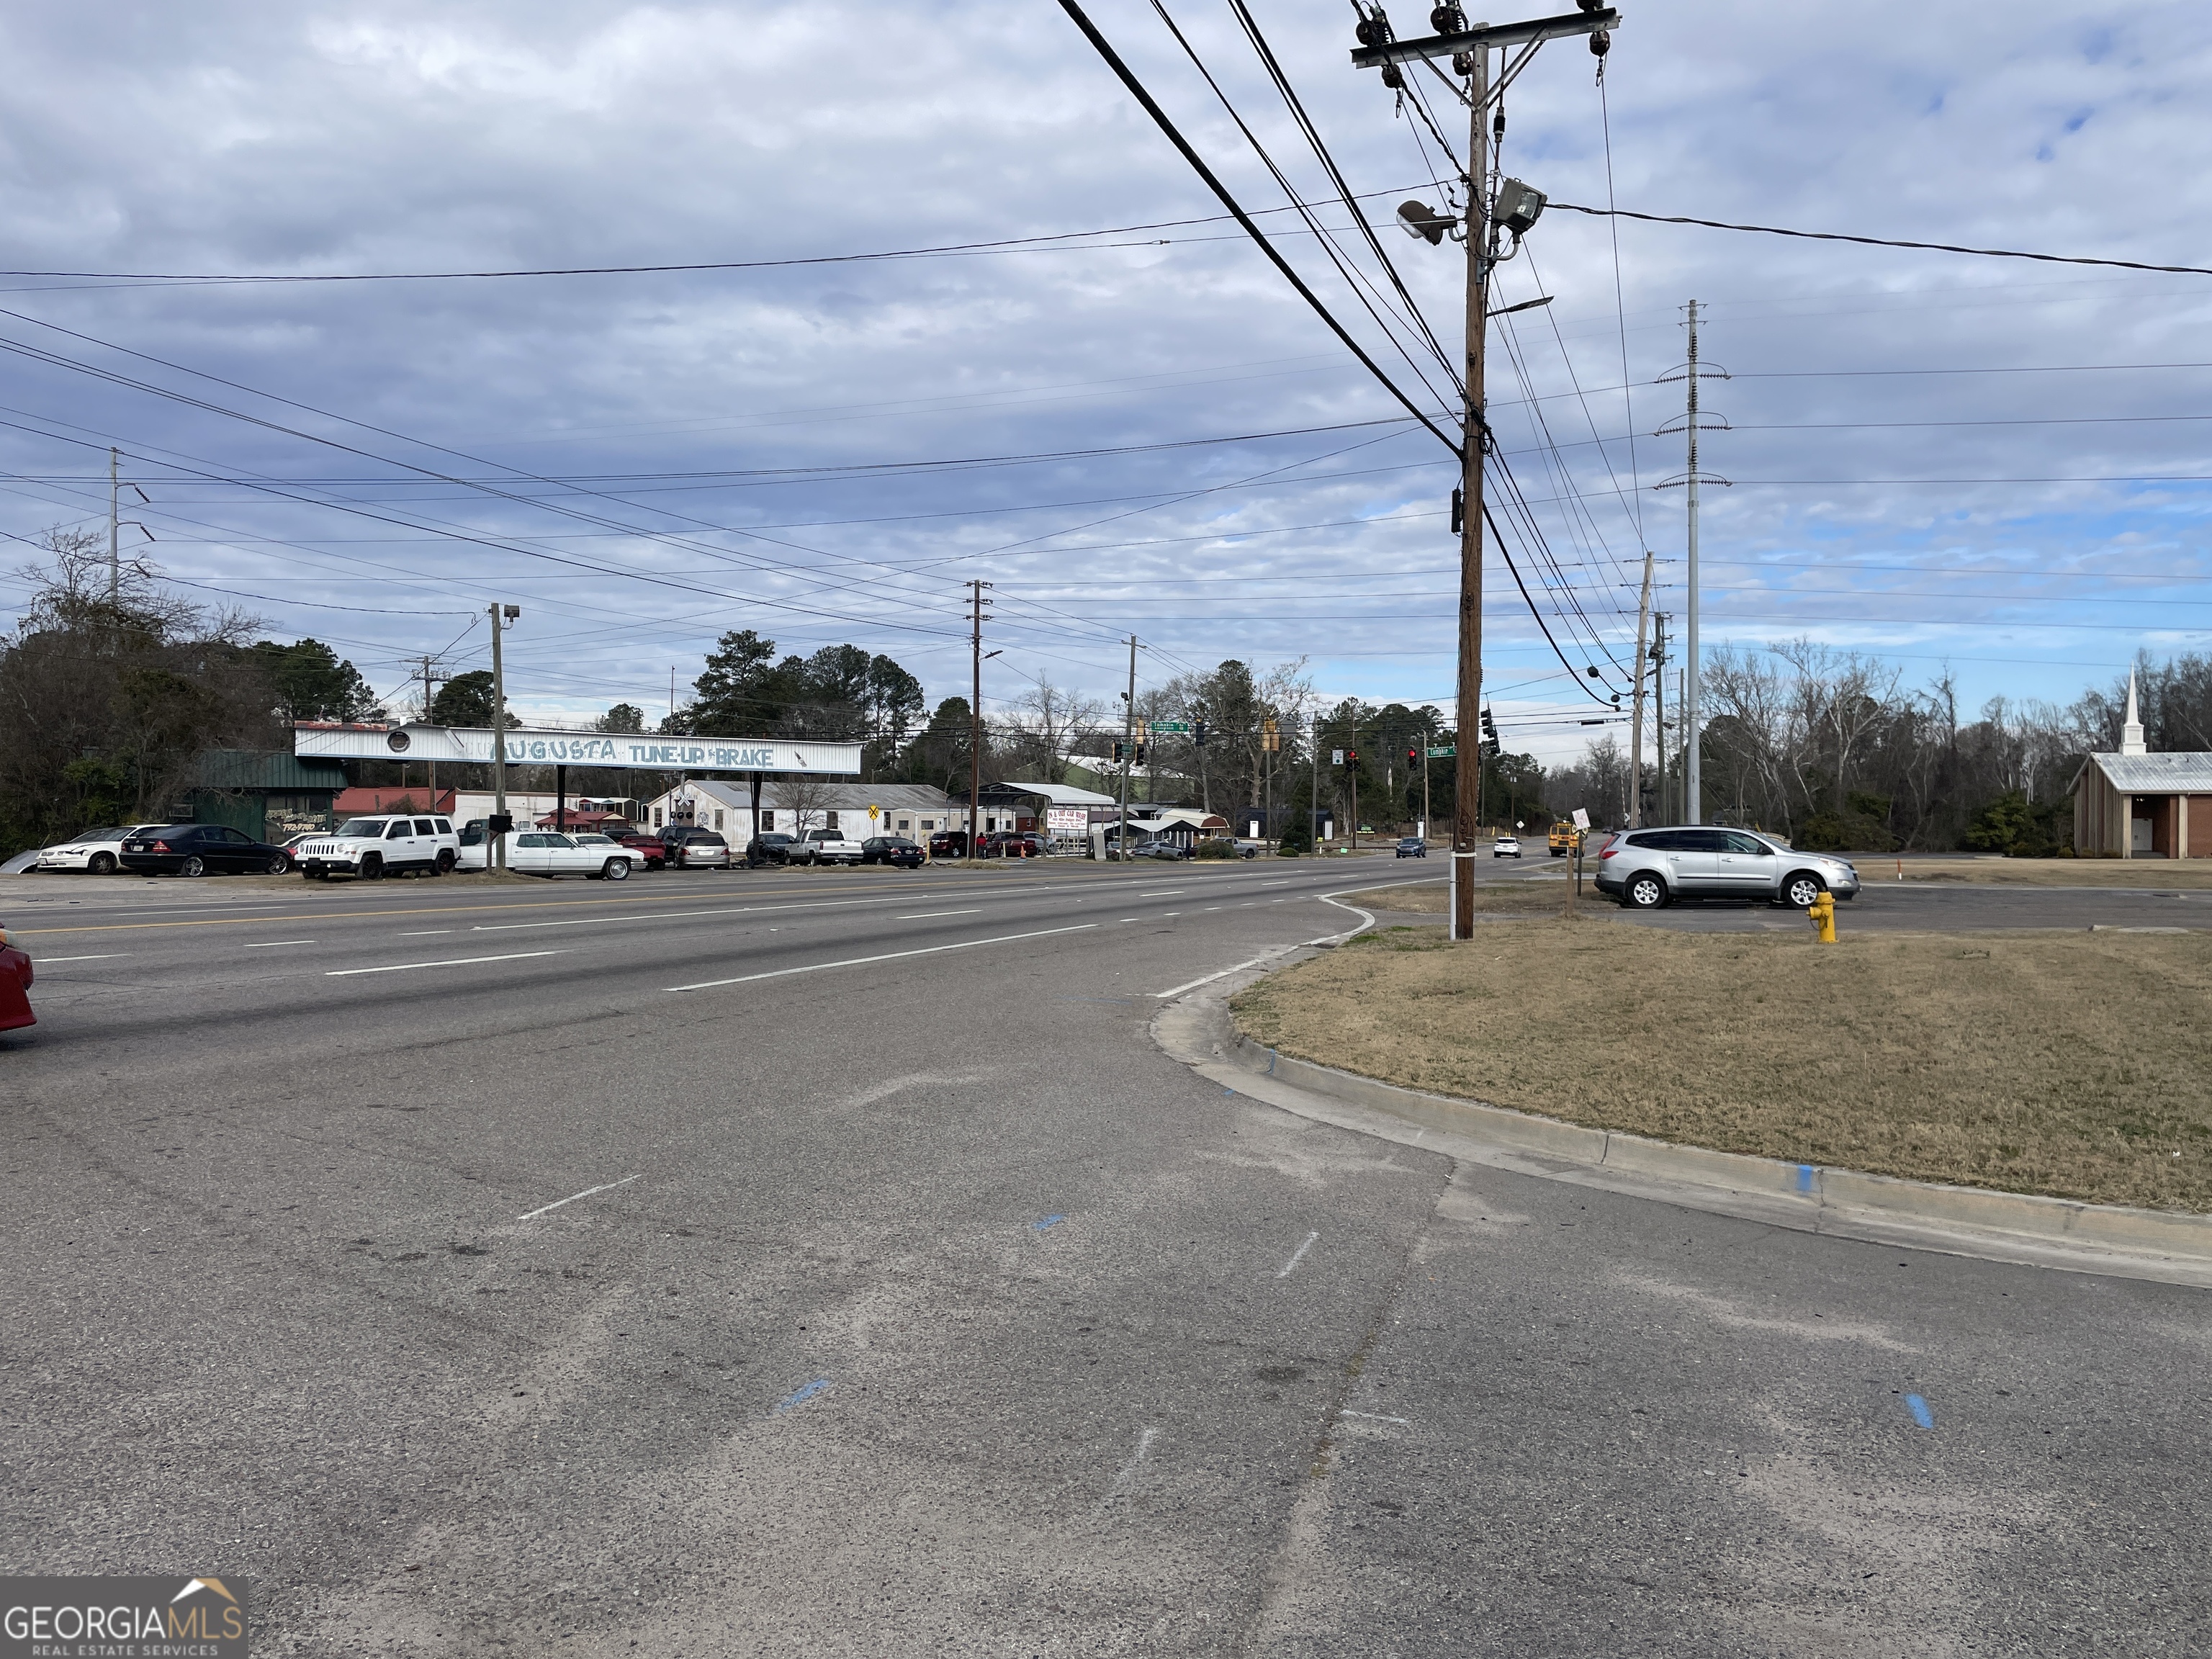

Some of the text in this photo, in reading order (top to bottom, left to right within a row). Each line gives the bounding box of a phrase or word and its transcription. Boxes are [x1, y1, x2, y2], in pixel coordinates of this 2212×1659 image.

[490, 739, 616, 760] AUGUSTA
[716, 747, 773, 766] BRAKE
[1430, 747, 1448, 756] Lumpkin
